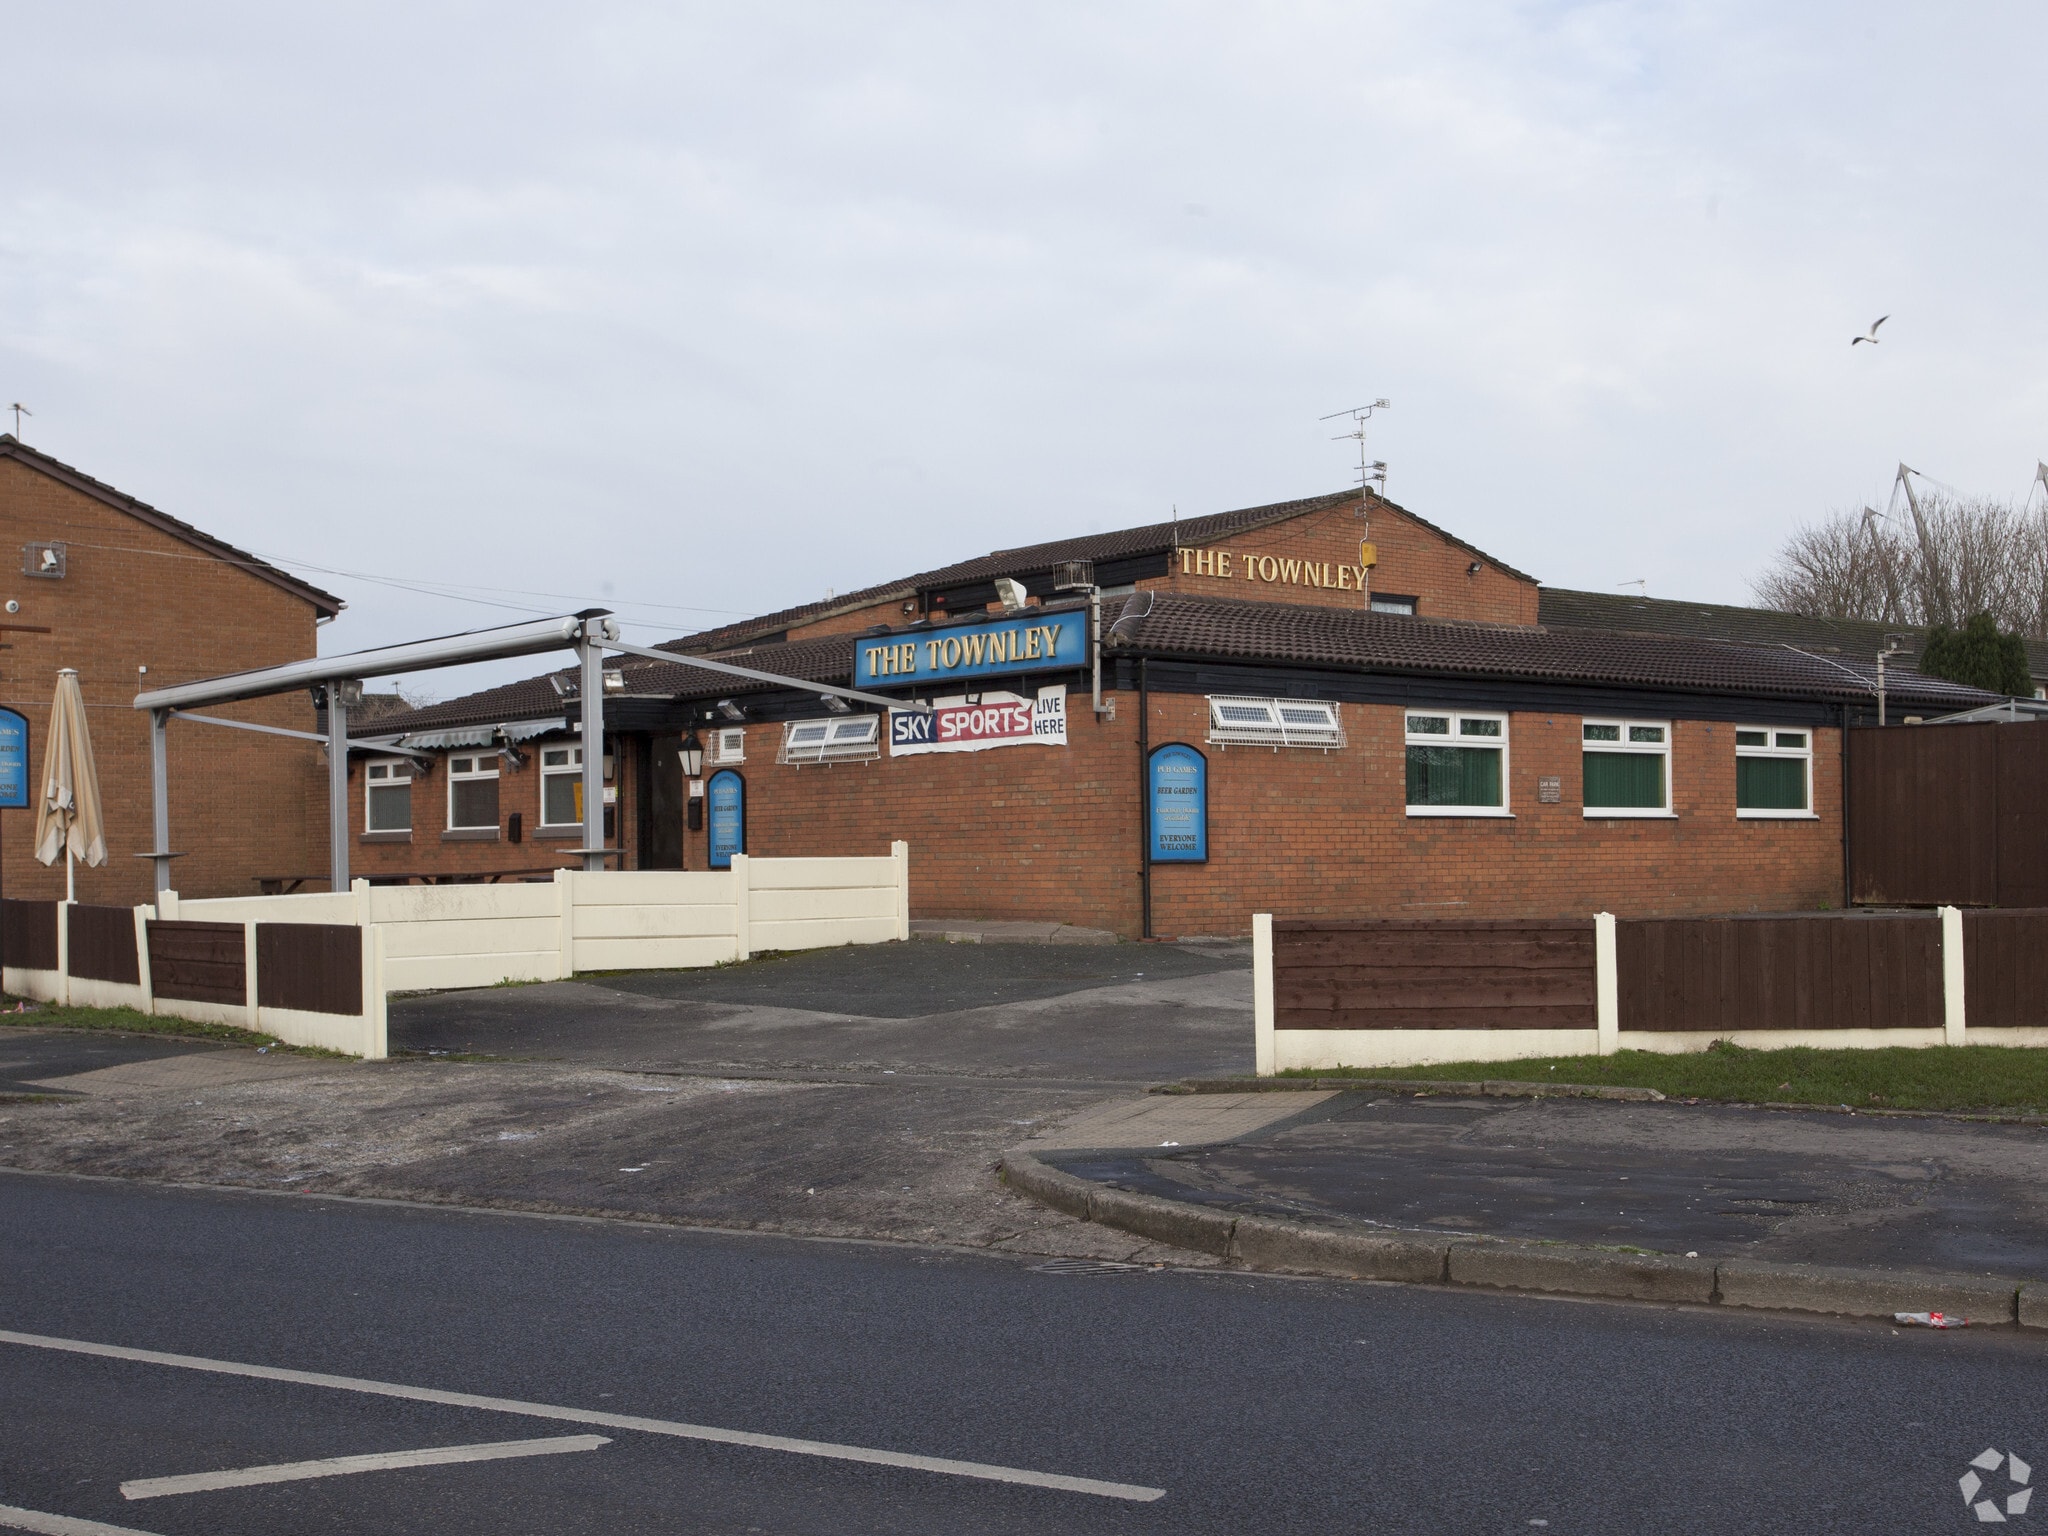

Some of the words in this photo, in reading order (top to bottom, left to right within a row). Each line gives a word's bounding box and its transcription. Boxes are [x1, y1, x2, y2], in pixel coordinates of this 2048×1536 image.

[1179, 548, 1232, 578] THE
[1242, 554, 1368, 591] TOWNLEY
[865, 643, 916, 677] THE
[926, 624, 1061, 670] TOWNLEY
[1037, 697, 1061, 714] LIVE
[895, 714, 932, 741] SKY
[940, 707, 1029, 738] SPORTS
[1034, 718, 1064, 735] HERE
[1157, 765, 1171, 773] PUB
[1173, 765, 1197, 773] GAMES
[1160, 843, 1197, 851] WELCOME
